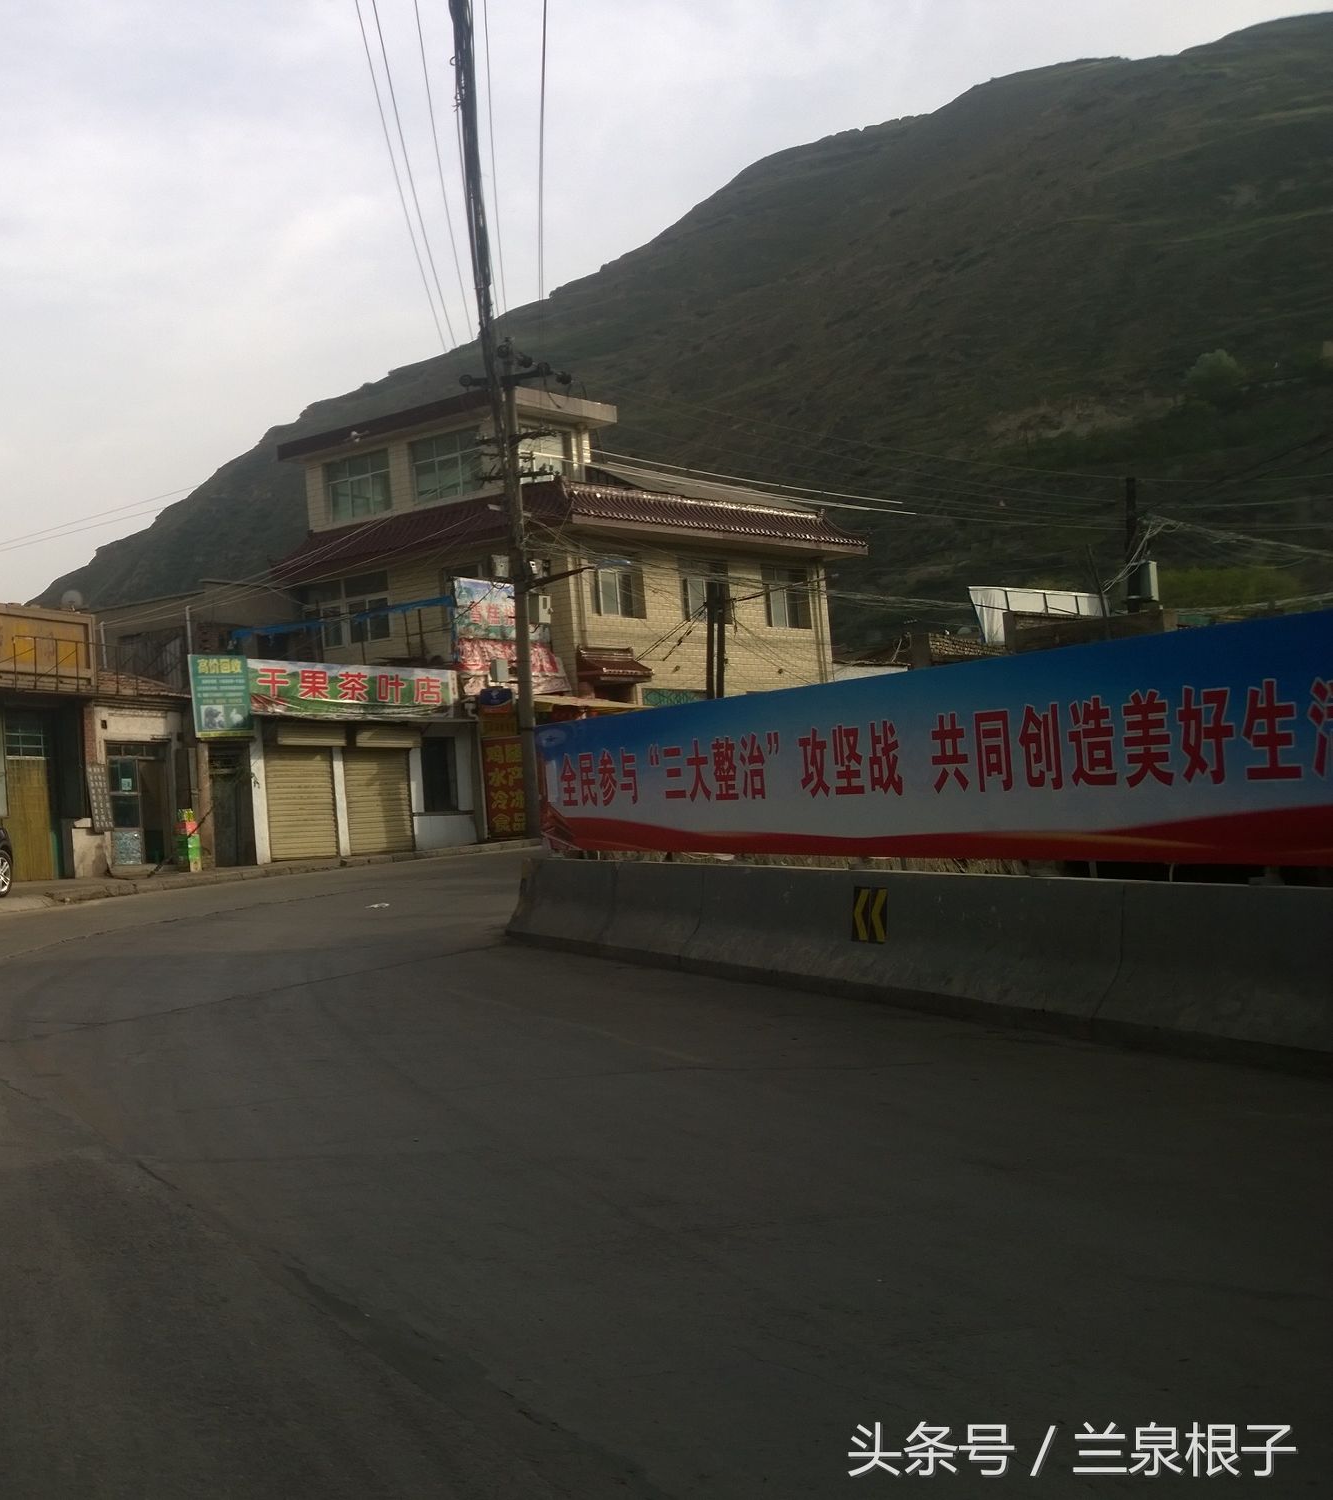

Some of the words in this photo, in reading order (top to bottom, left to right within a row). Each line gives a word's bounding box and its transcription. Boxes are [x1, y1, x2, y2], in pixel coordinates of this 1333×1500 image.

[257, 668, 443, 705] 干果茶叶店
